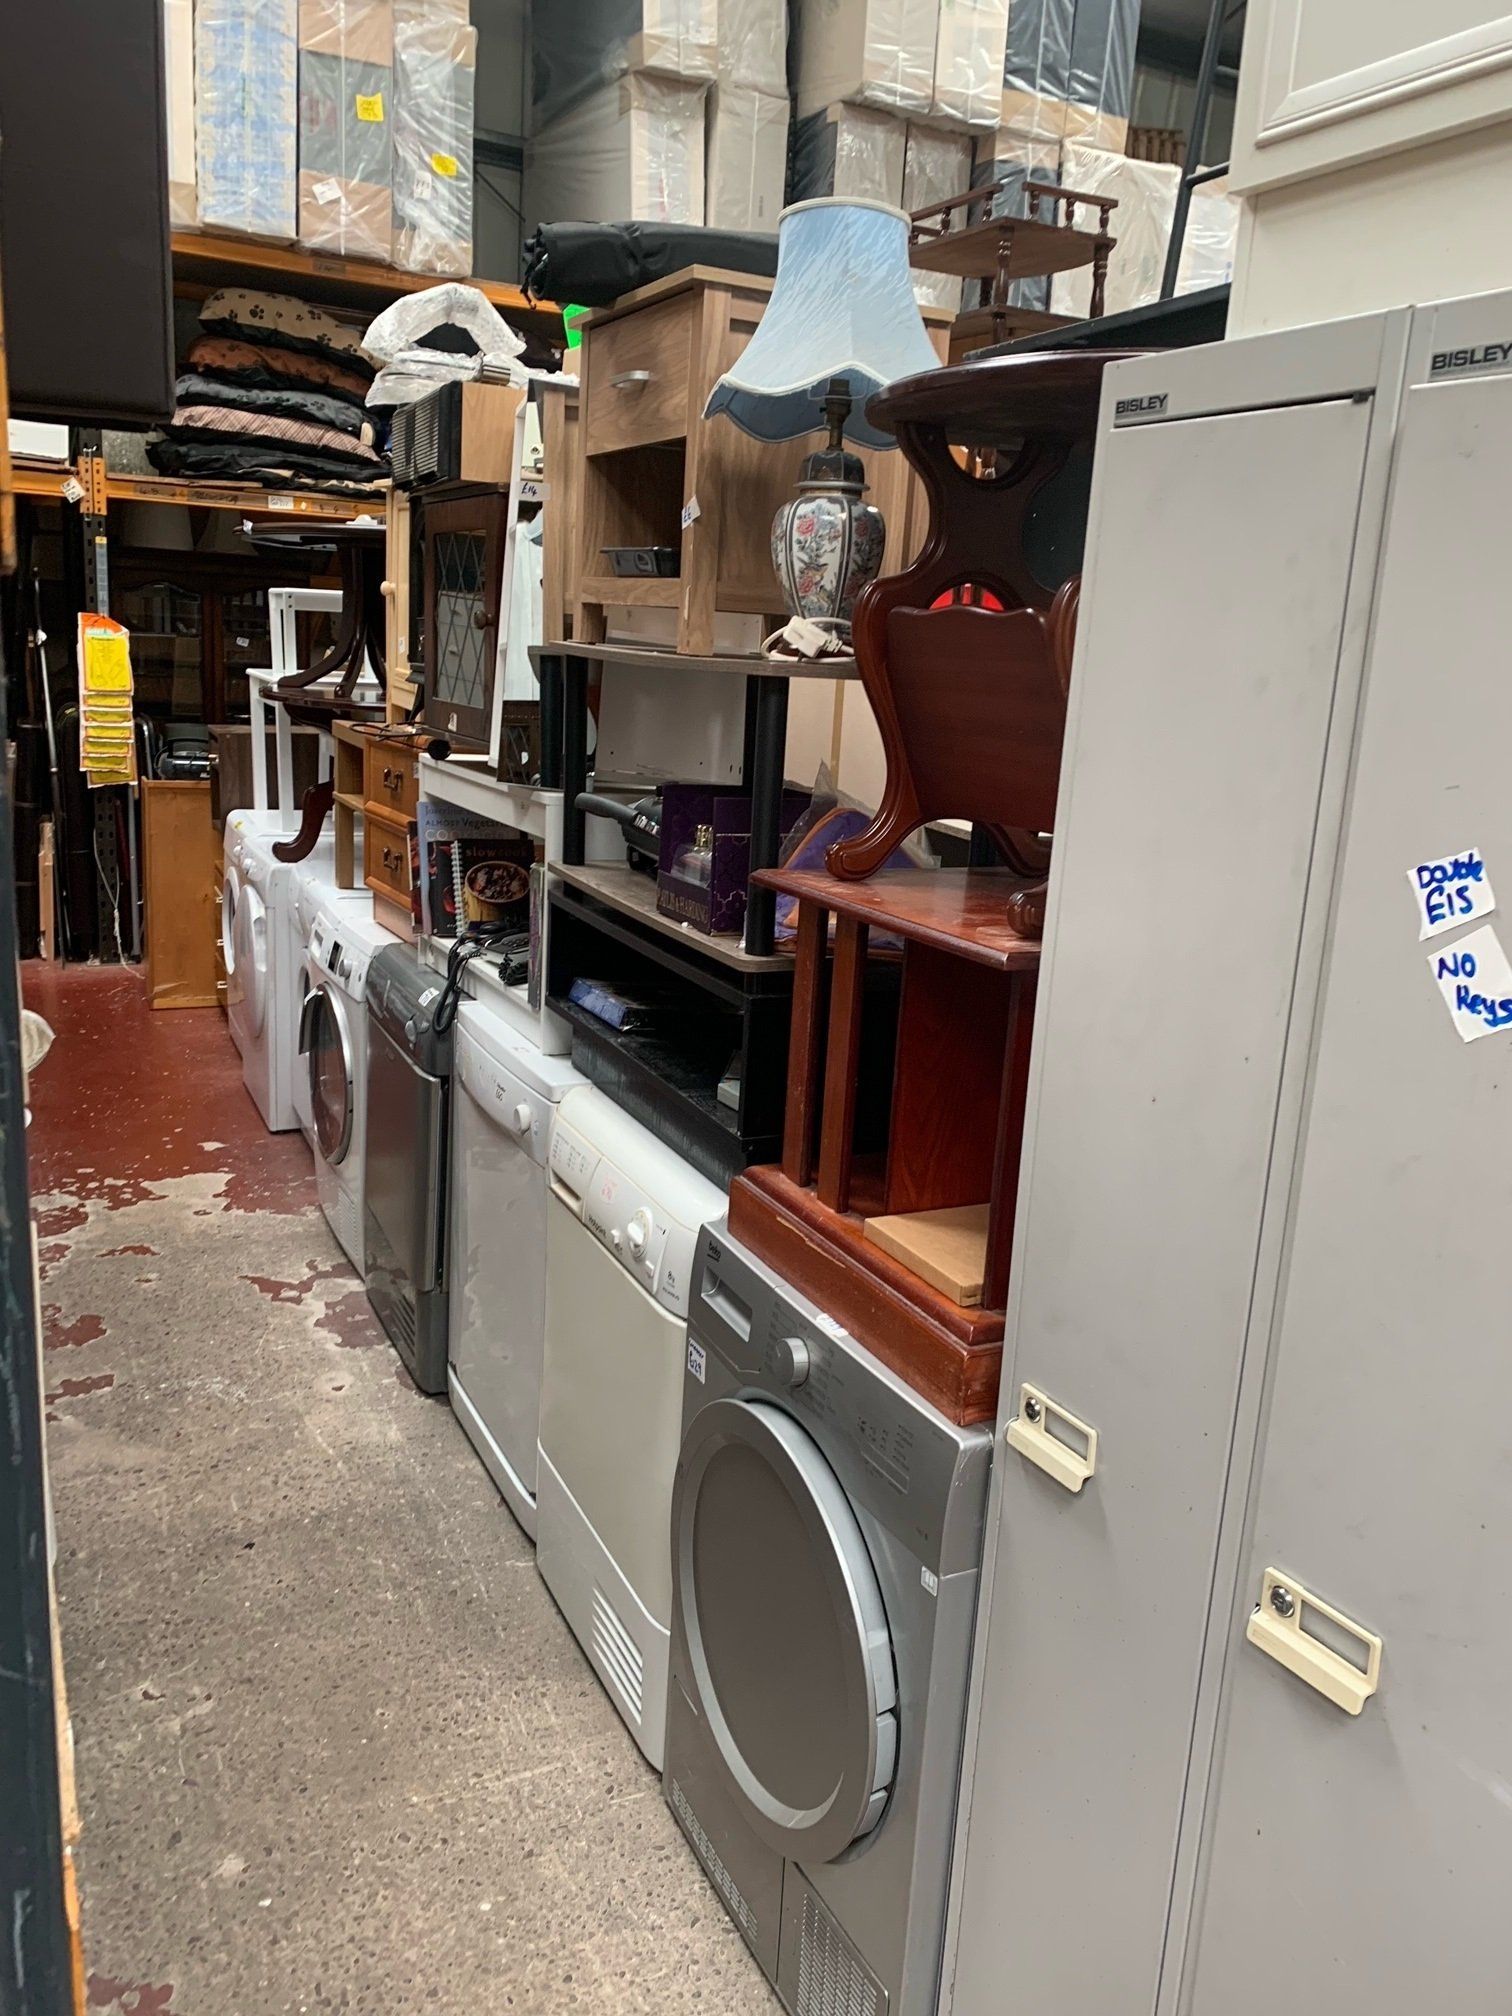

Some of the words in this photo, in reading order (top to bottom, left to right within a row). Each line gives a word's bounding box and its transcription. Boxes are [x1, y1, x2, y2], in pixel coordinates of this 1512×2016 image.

[1432, 342, 1512, 371] BISLEY
[1115, 393, 1168, 414] BISLEY
[1437, 952, 1476, 980] NO
[708, 1239, 721, 1259] beko
